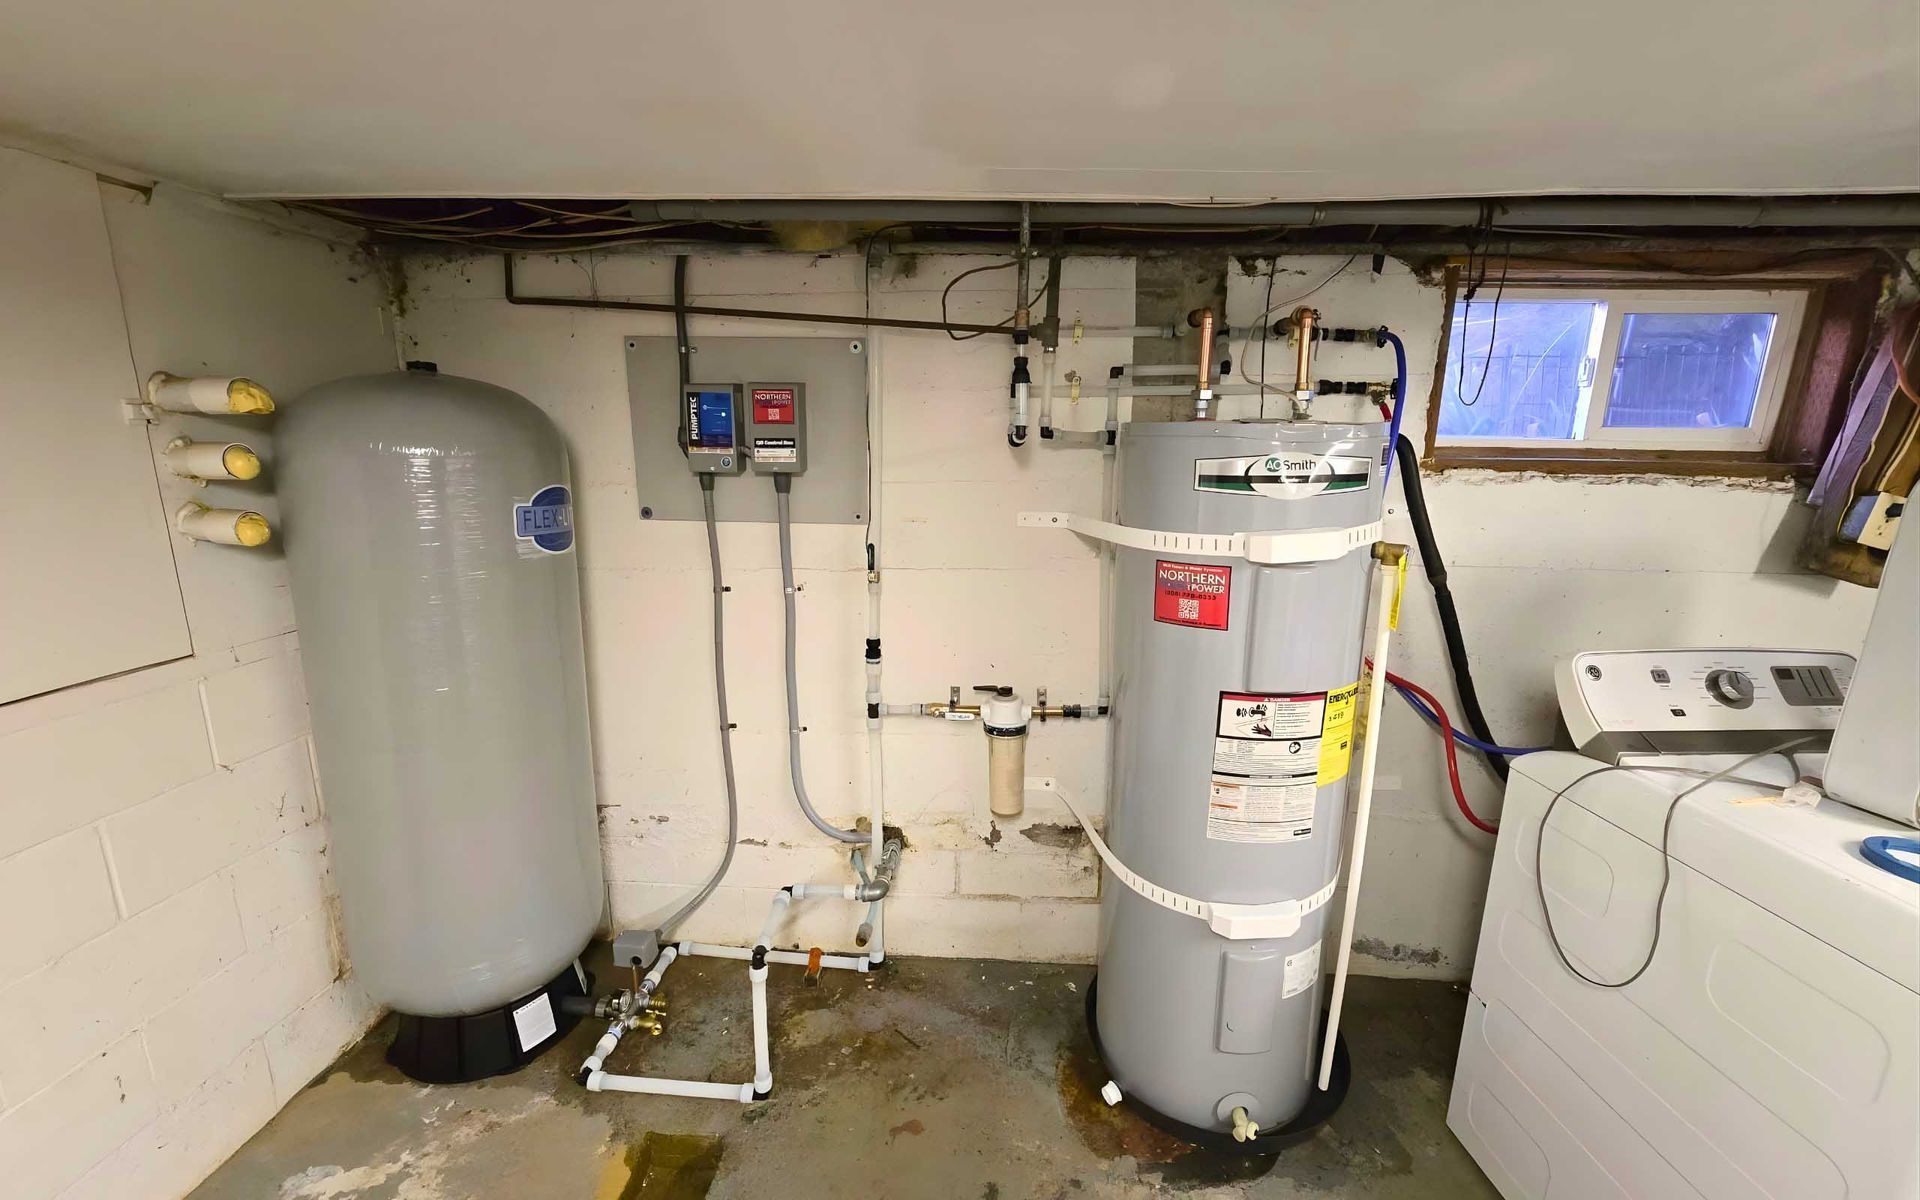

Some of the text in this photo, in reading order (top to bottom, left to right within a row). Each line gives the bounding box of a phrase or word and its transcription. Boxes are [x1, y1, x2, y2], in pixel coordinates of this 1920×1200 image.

[689, 396, 699, 440] PUMPTEC
[1283, 459, 1316, 470] Smith
[1159, 569, 1226, 585] NORTHERN
